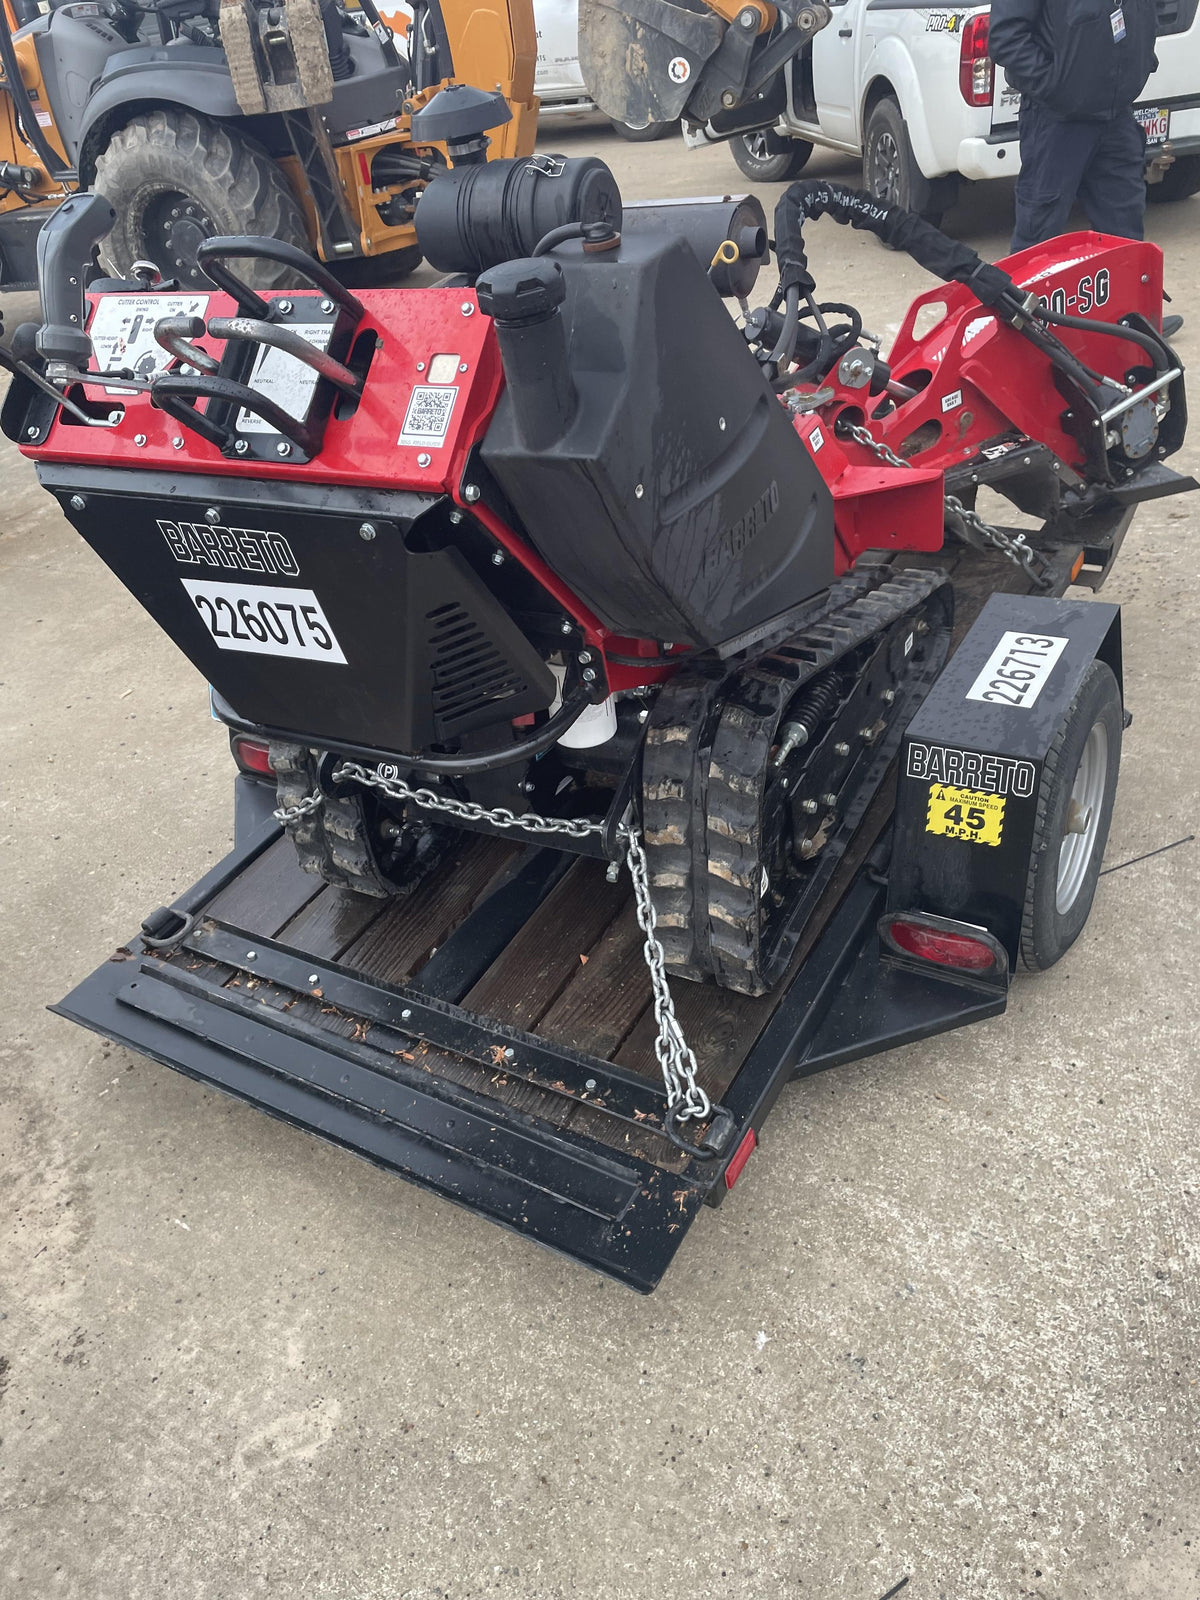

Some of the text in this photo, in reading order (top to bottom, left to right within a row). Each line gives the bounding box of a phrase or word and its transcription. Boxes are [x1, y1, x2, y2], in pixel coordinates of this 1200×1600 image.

[1137, 117, 1167, 136] WKG
[417, 407, 442, 416] BARRETO
[156, 519, 300, 576] BARRETO
[195, 594, 333, 651] 226075
[982, 636, 1054, 705] 226713
[906, 742, 1036, 798] BARRETO
[949, 796, 999, 811] MAXIMUM SPEED
[960, 793, 989, 803] CAUTION
[943, 804, 986, 830] 45
[945, 825, 982, 840] M.P.H.
